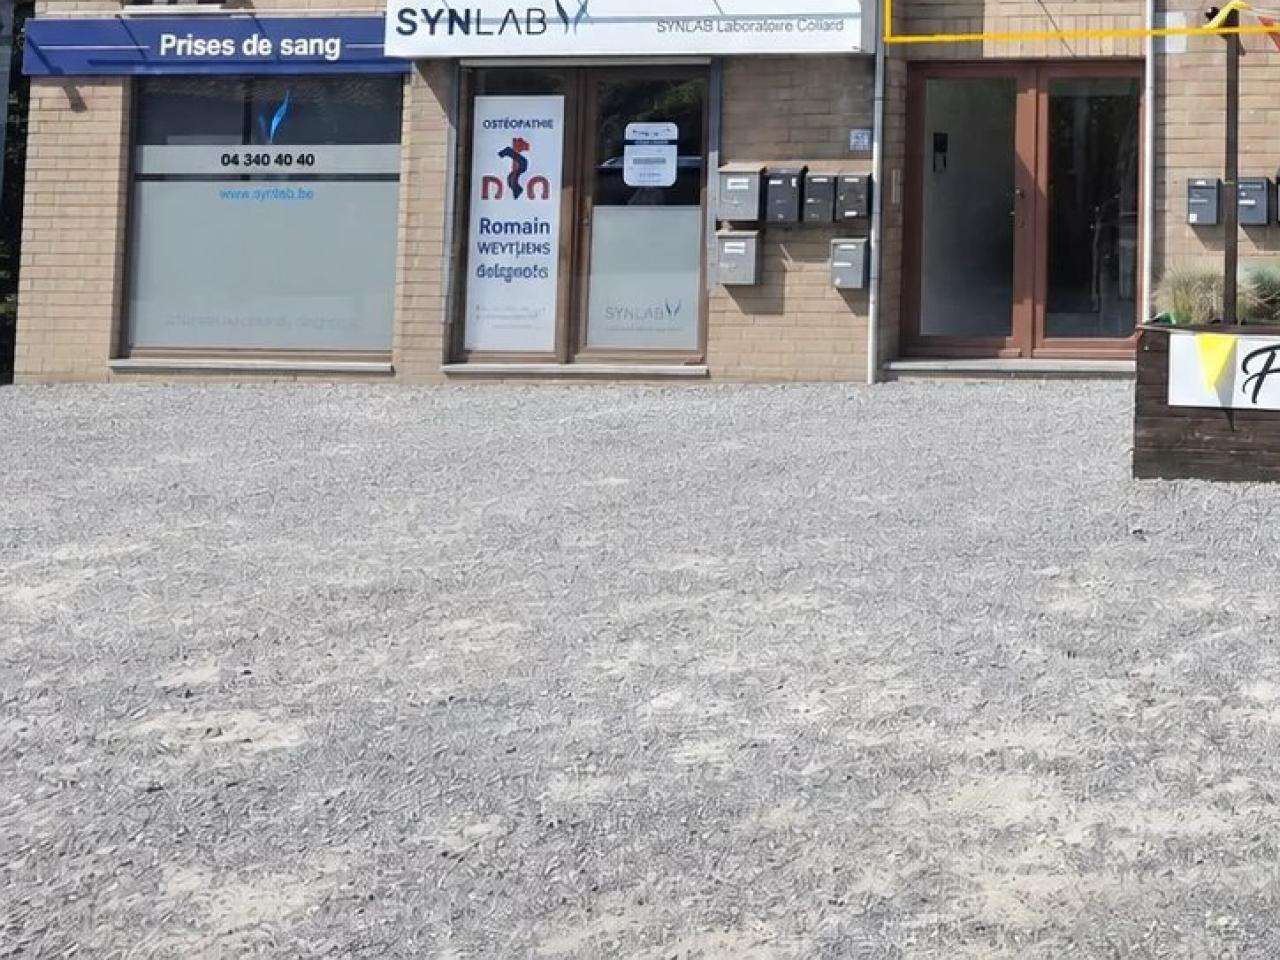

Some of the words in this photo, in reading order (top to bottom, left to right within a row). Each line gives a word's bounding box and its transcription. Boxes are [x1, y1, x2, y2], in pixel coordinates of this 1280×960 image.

[395, 7, 548, 36] SYNLAB
[656, 18, 713, 33] SYNLAB
[717, 18, 794, 33] Laboratoire
[160, 32, 236, 56] Prises
[242, 32, 273, 56] de
[280, 36, 342, 61] sang
[220, 153, 240, 167] 04
[243, 153, 271, 167] 340
[274, 153, 293, 167] 40
[296, 153, 316, 167] 40
[478, 216, 551, 235] Romain
